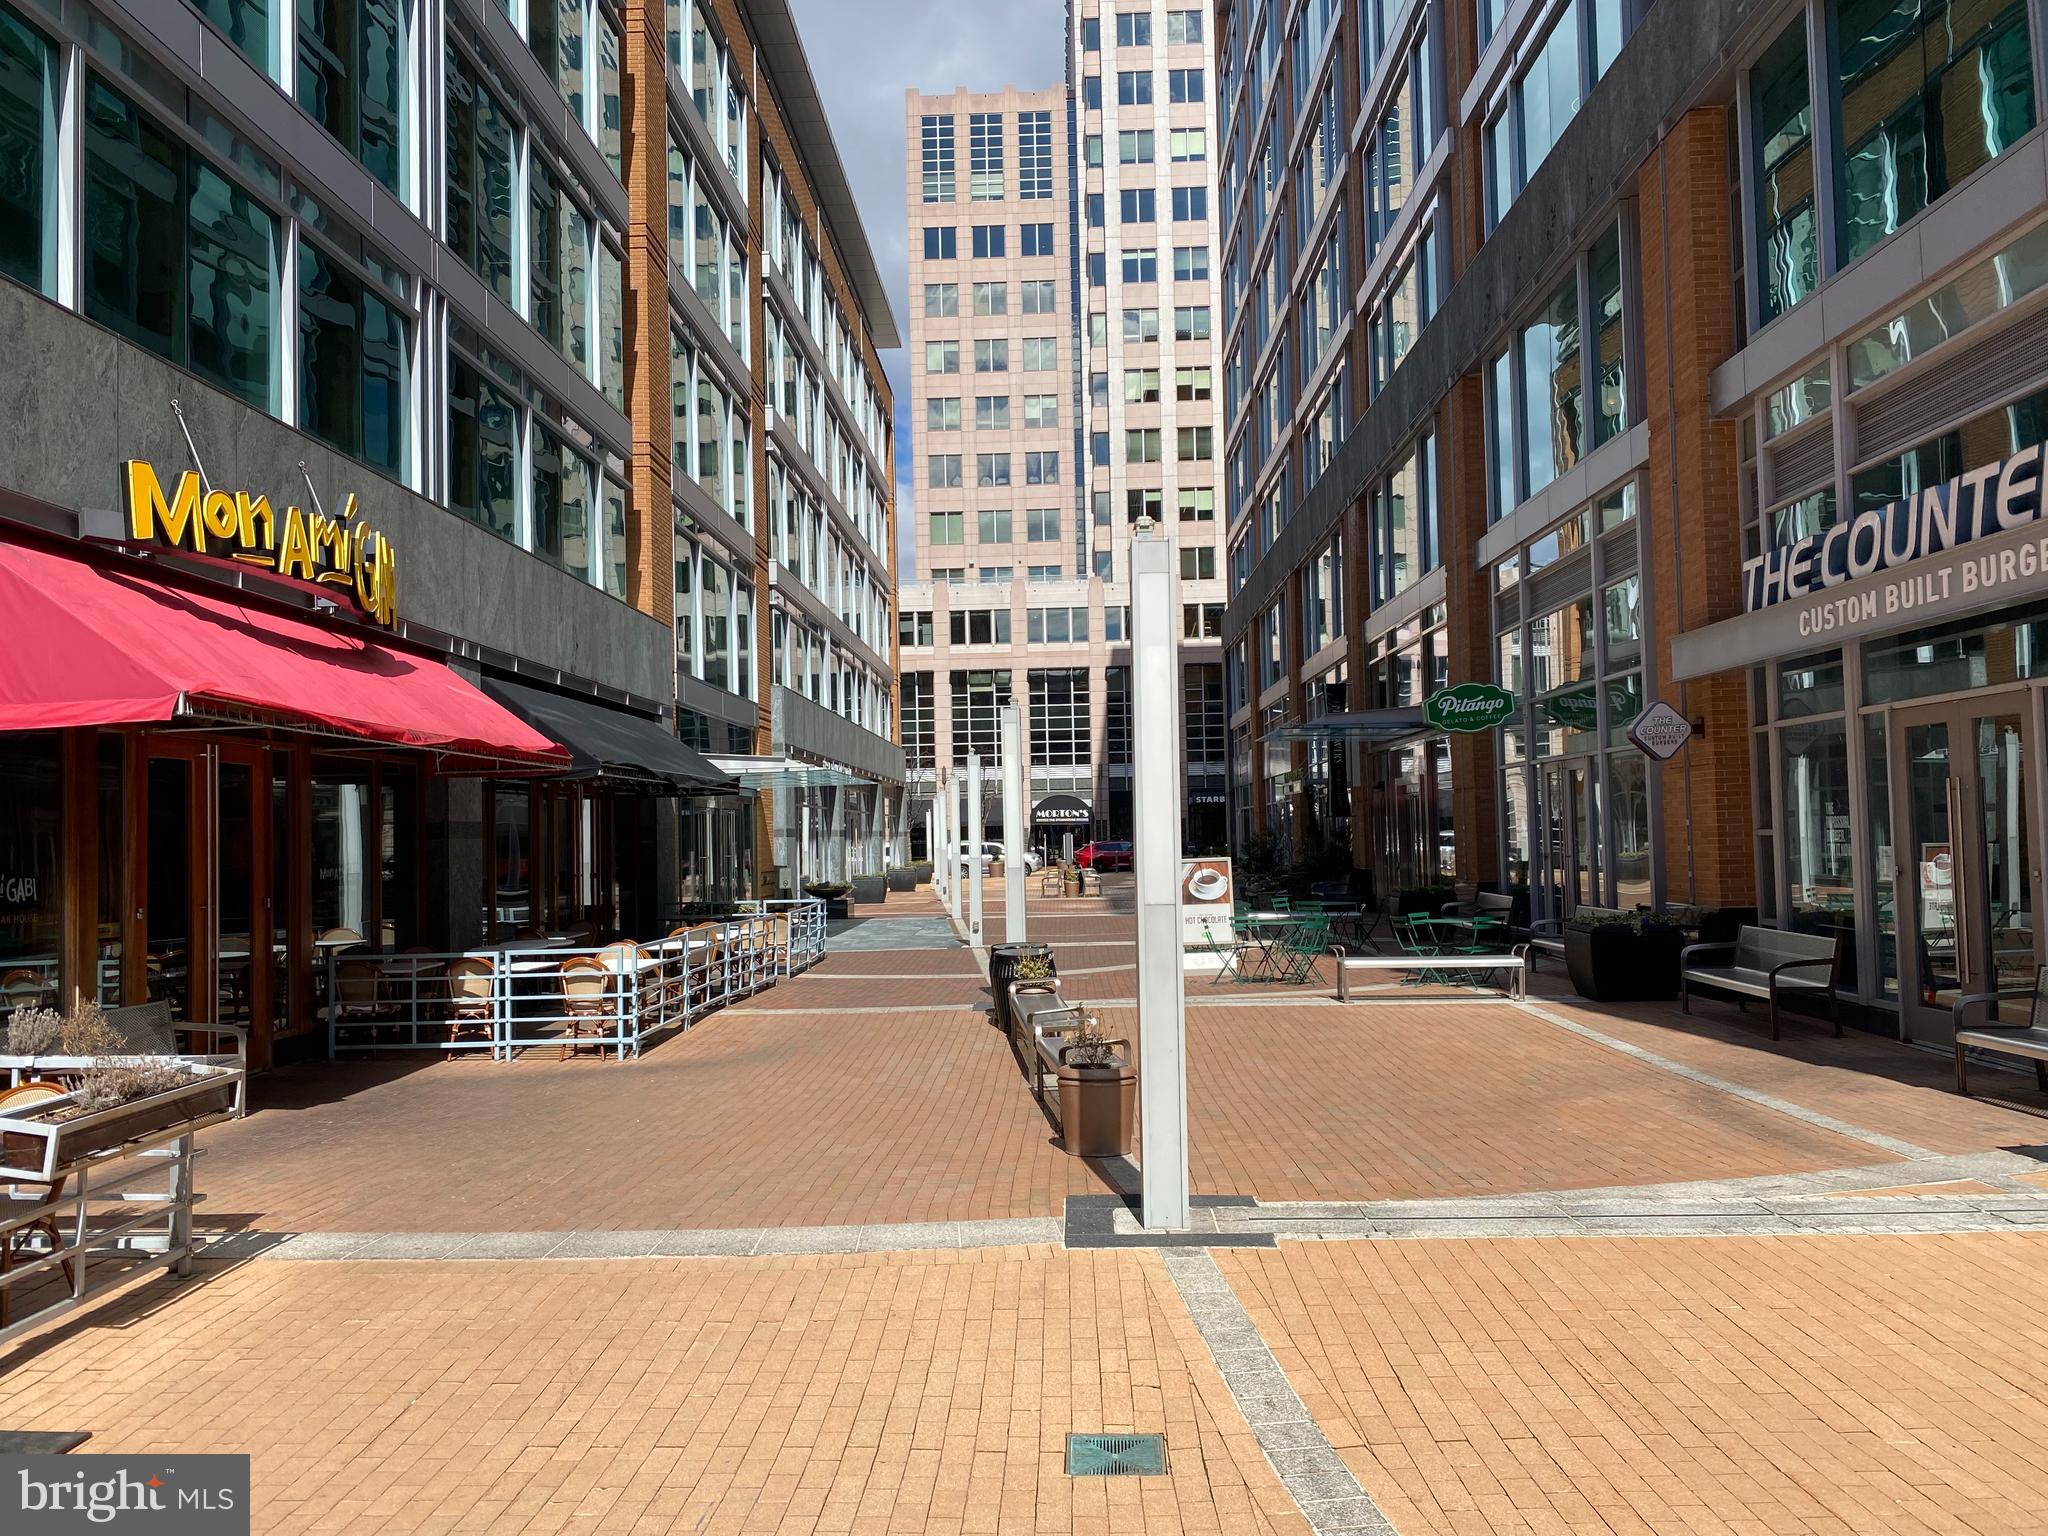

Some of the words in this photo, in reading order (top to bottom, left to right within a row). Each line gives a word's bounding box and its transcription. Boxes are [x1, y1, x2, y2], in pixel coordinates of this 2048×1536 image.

[1743, 537, 1813, 614] THE
[1821, 440, 2048, 589] COUNTE
[1799, 590, 1877, 637] CUSTOM
[1885, 567, 1952, 615] BUILT
[1438, 695, 1505, 716] Pitango
[1442, 717, 1467, 725] GELATO
[1476, 713, 1502, 721] COFFEE
[1654, 716, 1673, 725] THE
[1640, 724, 1687, 736] COUNTER
[1036, 809, 1089, 818] MORTON'S
[6, 878, 37, 903] GABI
[1185, 916, 1196, 924] HOT
